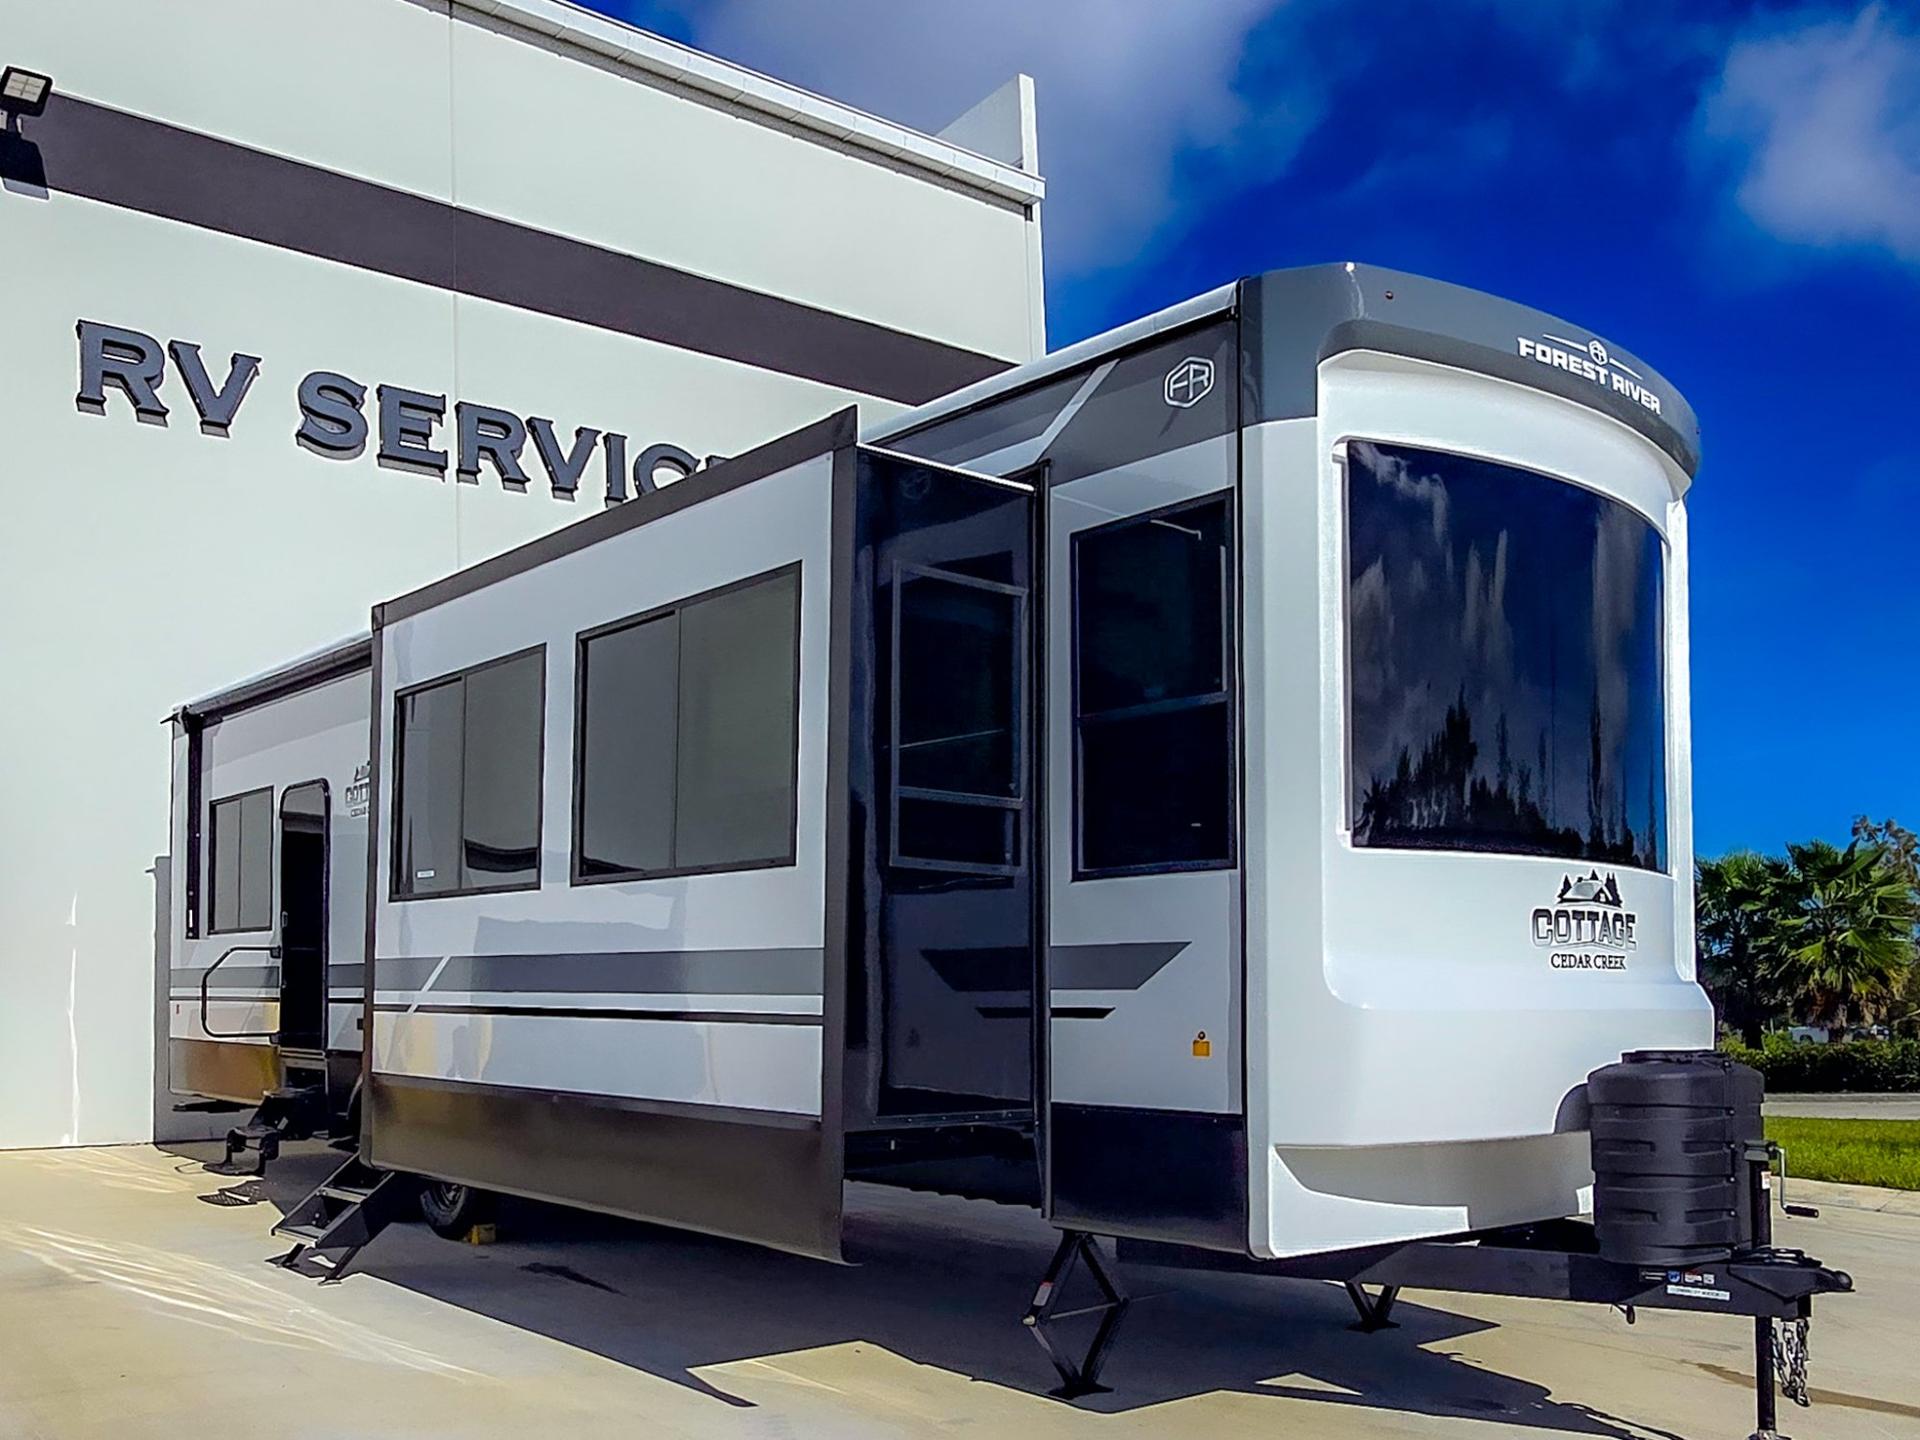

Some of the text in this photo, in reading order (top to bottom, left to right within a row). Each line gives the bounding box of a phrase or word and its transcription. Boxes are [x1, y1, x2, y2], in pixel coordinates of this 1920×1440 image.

[1517, 337, 1662, 415] FOREST RIVER
[75, 319, 731, 508] RV SERVIC
[345, 782, 370, 808] COTT
[1532, 908, 1637, 951] COTTAGE
[1551, 953, 1627, 970] CEDAR CREEK
